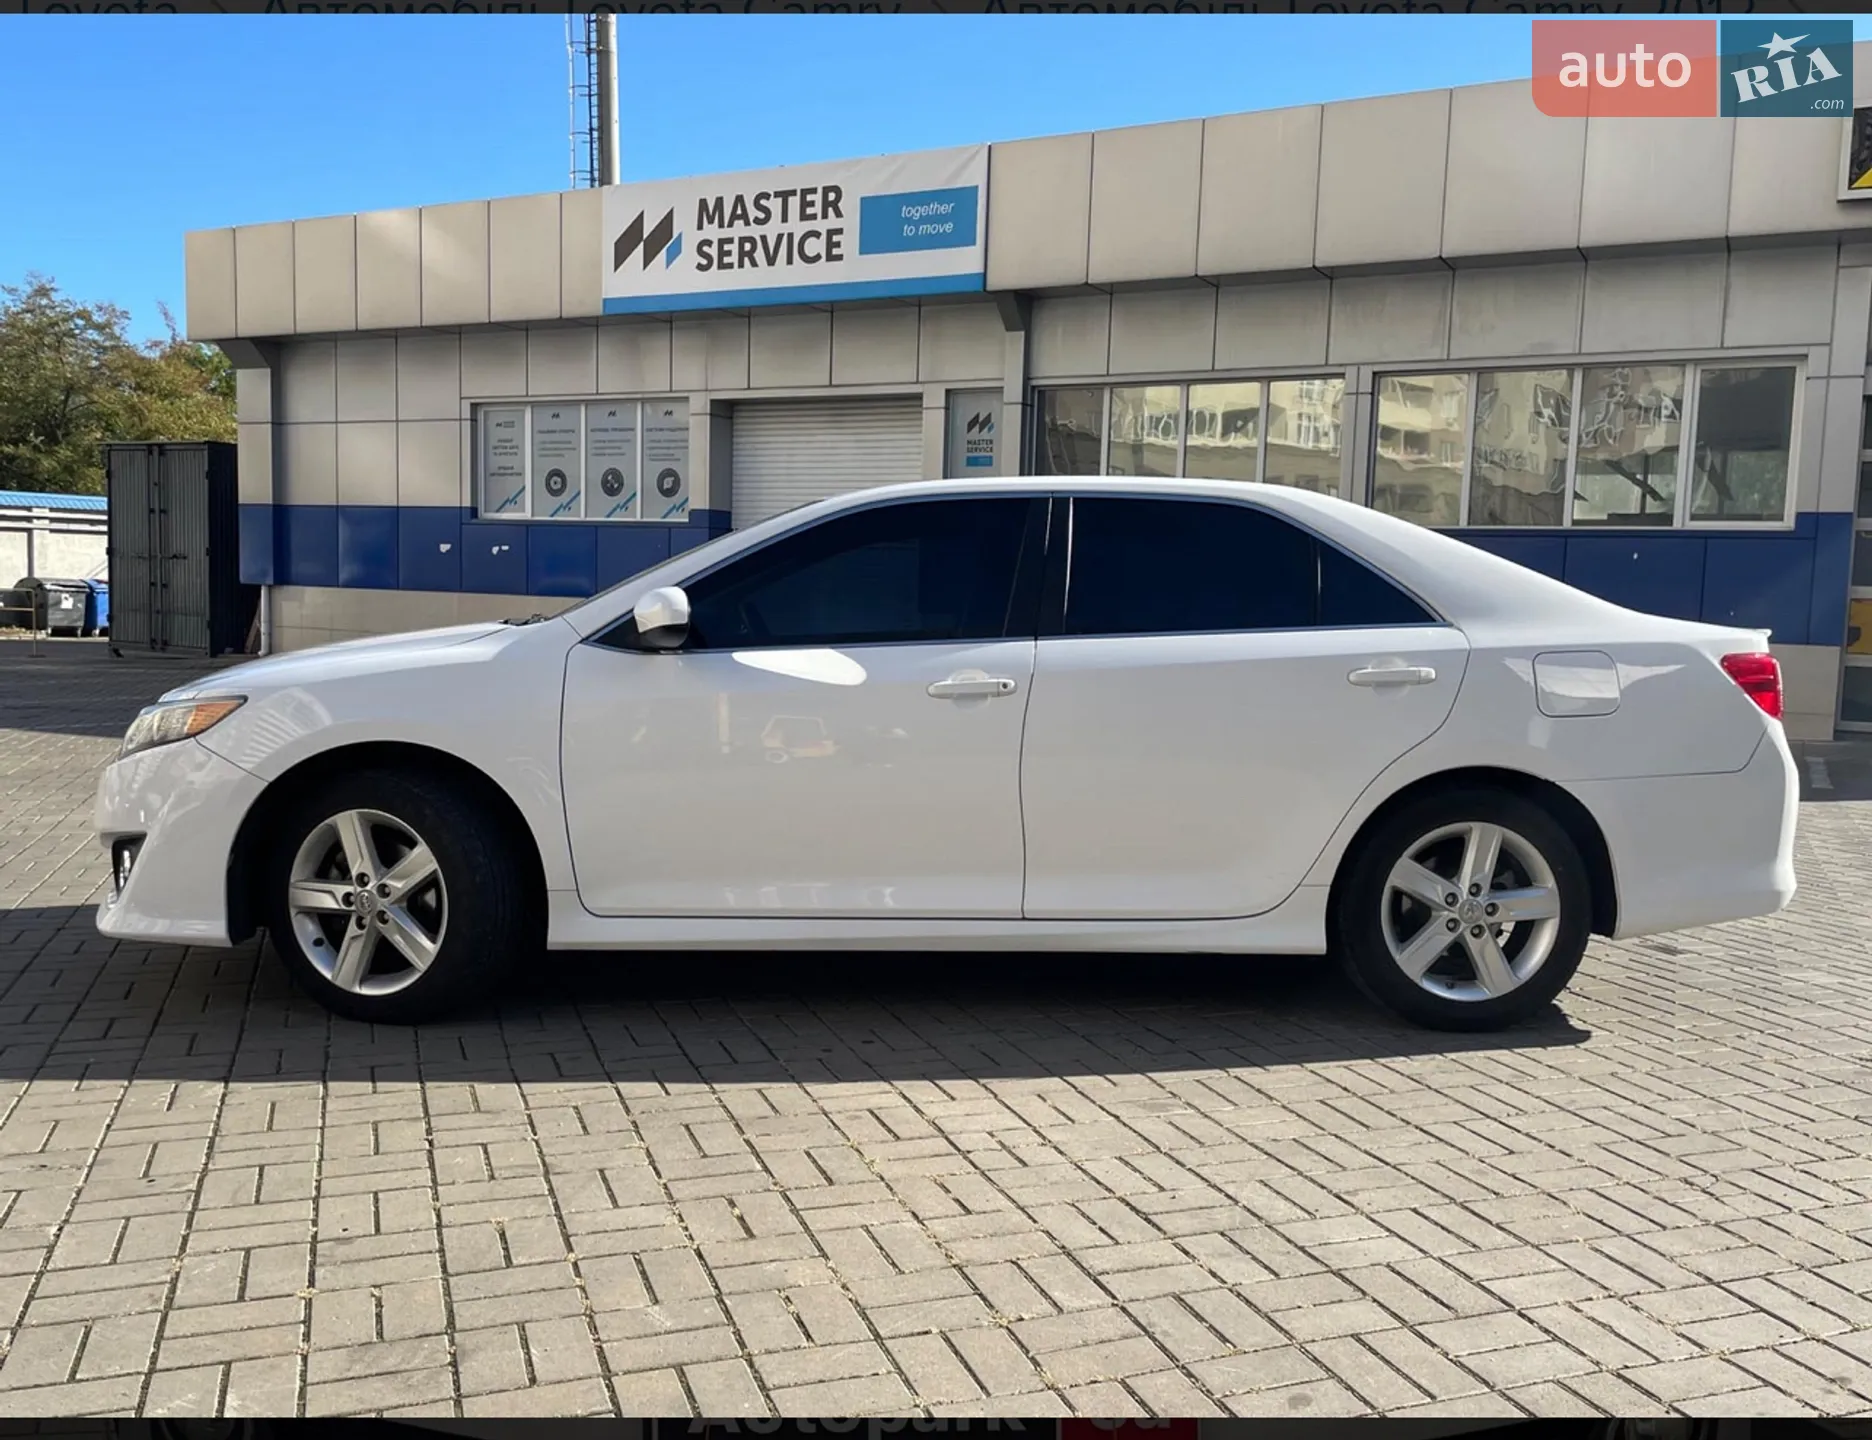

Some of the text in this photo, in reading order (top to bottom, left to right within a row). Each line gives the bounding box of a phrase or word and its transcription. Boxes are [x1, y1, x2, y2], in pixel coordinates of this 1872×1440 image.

[696, 184, 844, 231] MASTER
[901, 201, 956, 220] together
[903, 221, 954, 237] to move
[695, 227, 844, 272] SERVICE
